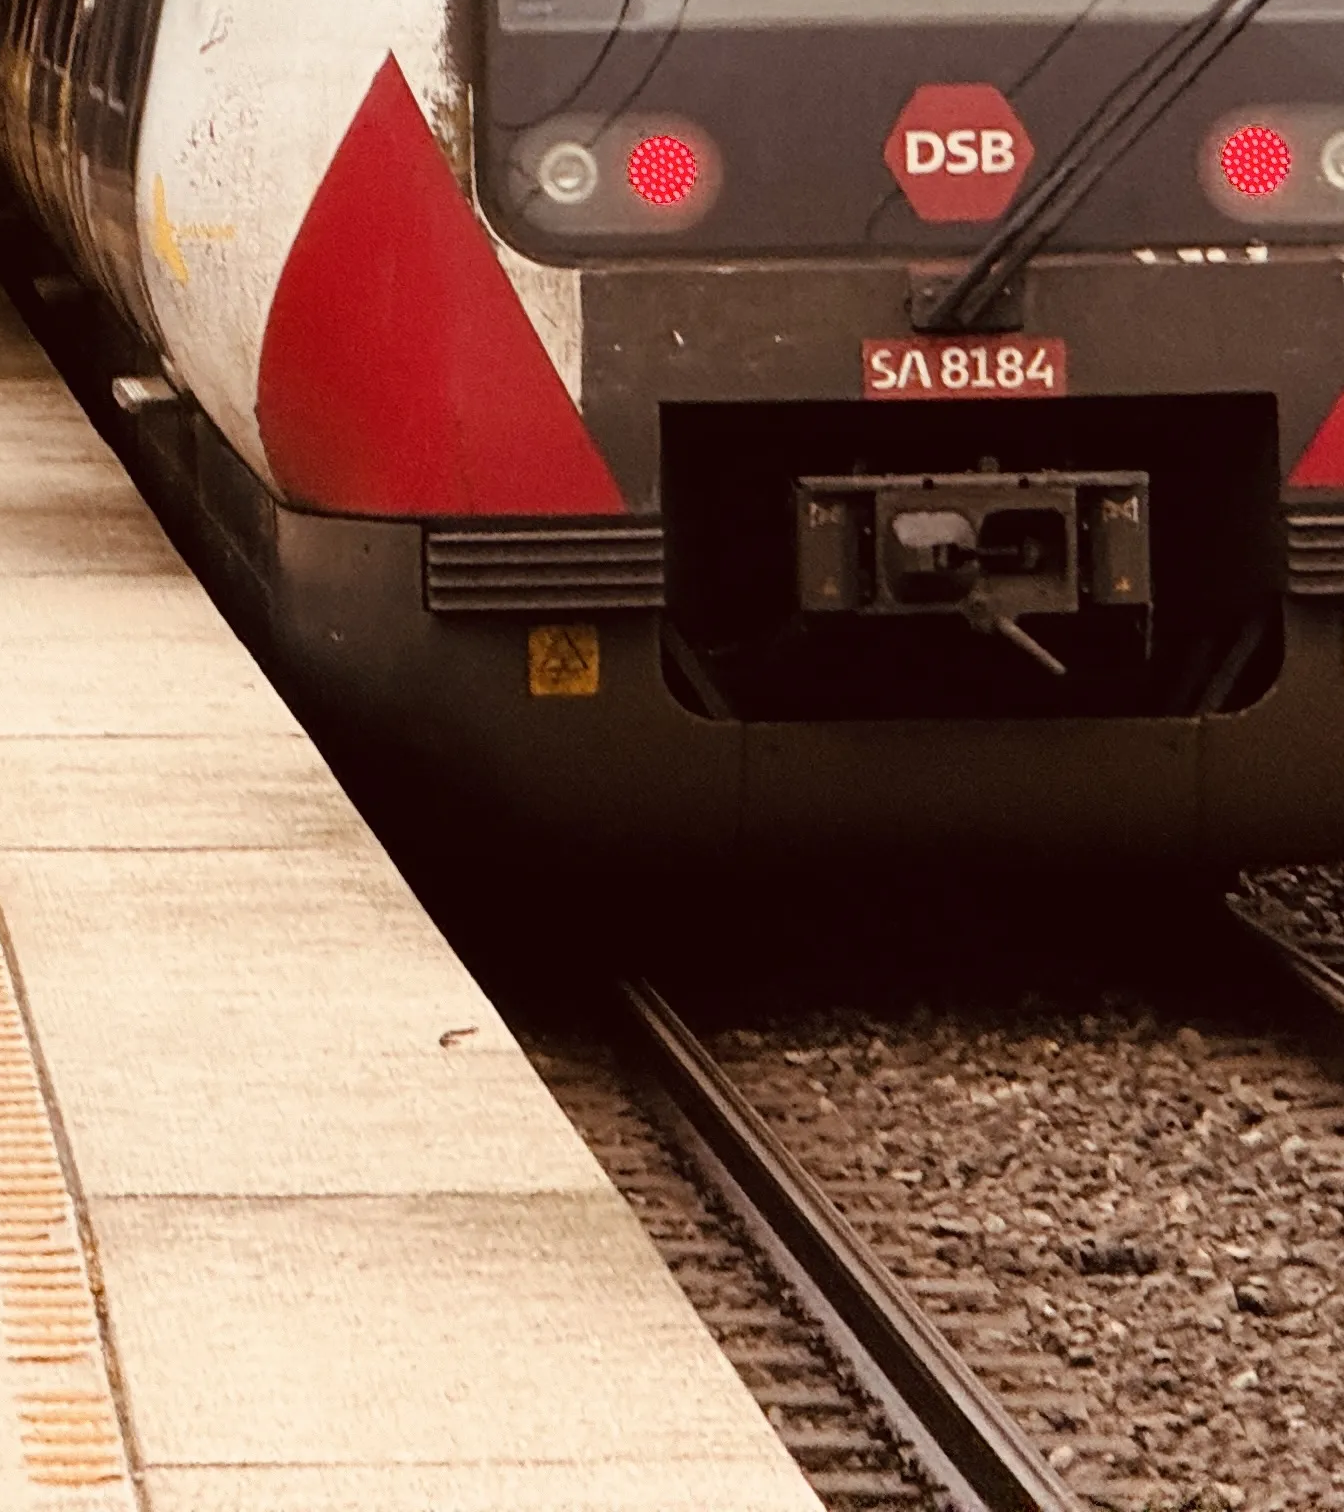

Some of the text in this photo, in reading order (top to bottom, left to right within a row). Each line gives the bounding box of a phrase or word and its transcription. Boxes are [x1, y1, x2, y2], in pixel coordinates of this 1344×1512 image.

[904, 129, 1016, 175] DSB
[870, 345, 1055, 390] SA 8184
